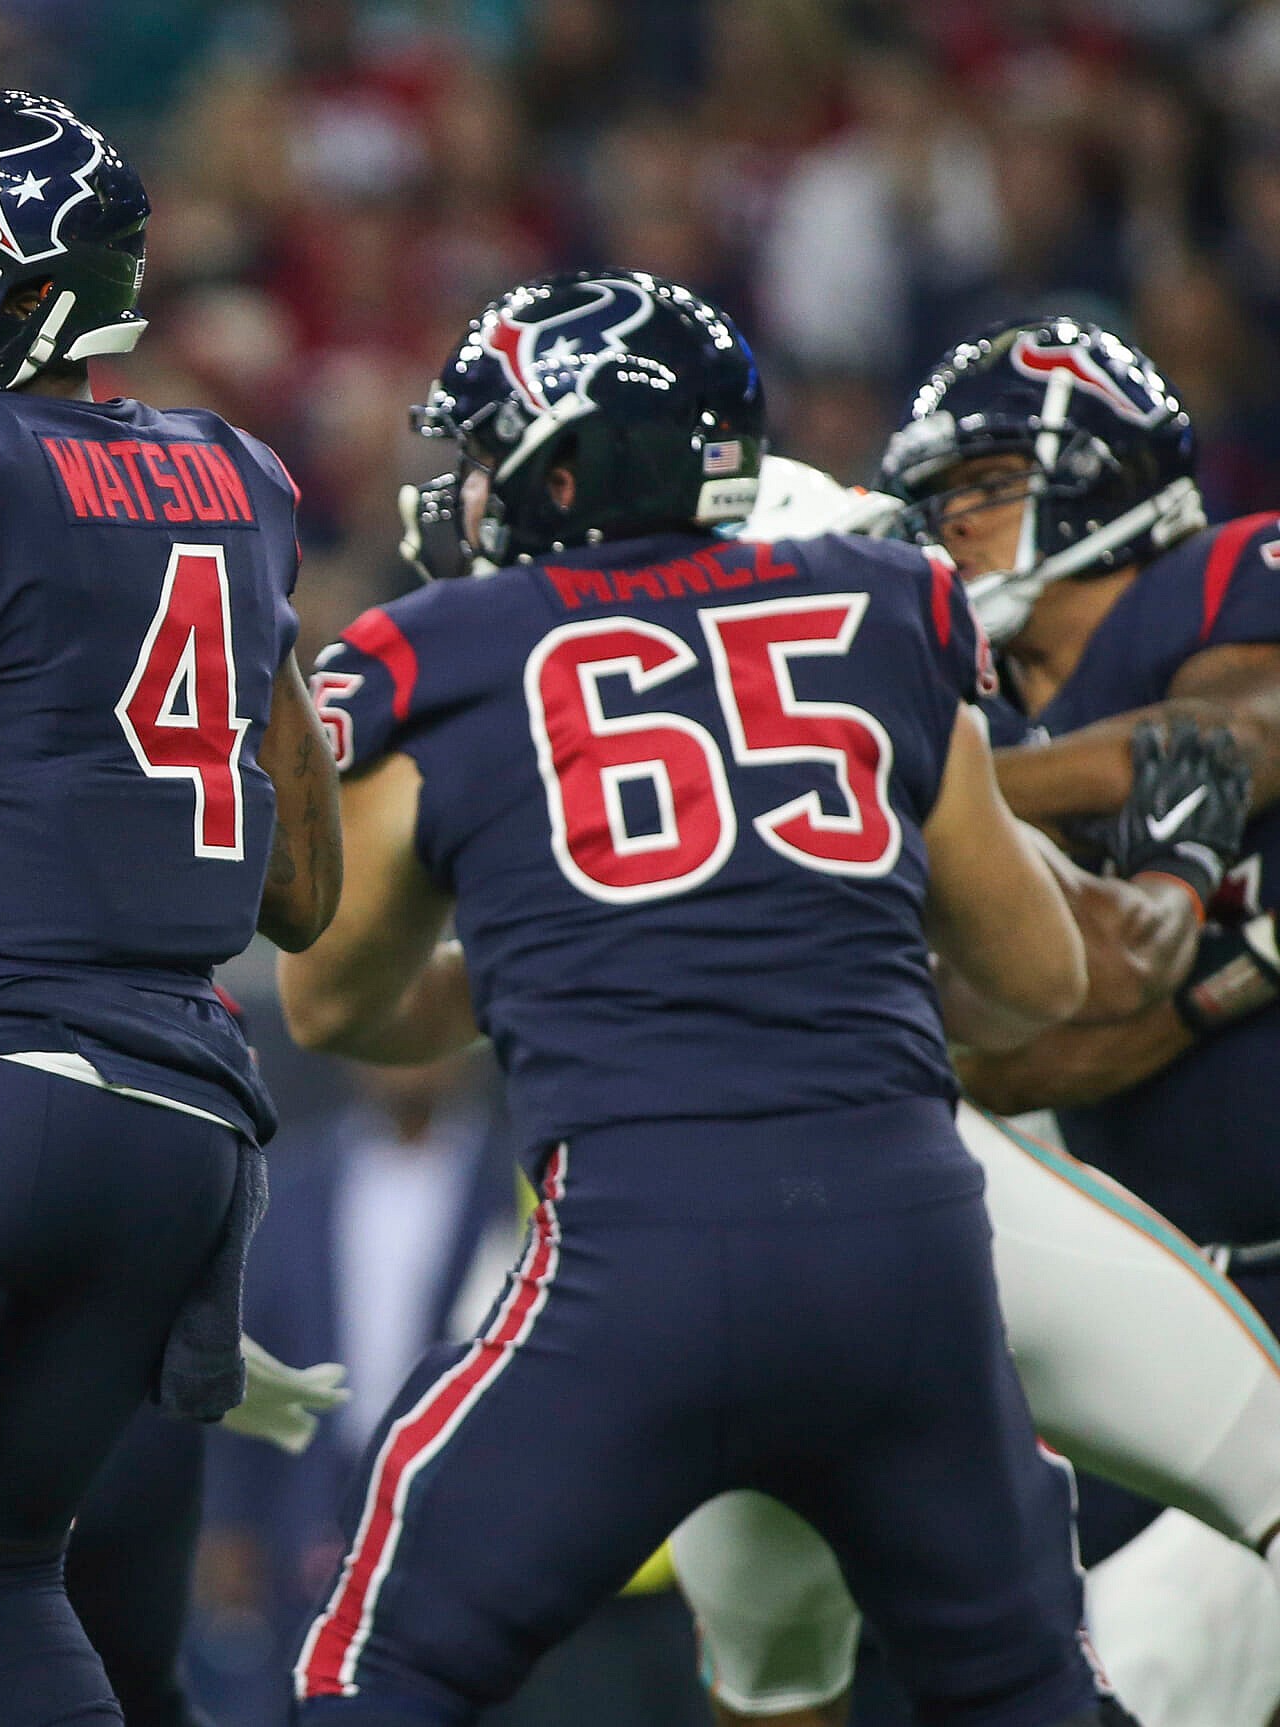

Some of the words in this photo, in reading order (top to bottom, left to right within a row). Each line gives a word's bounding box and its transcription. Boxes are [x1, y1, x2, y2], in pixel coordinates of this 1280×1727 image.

[41, 437, 254, 523] WATSON
[114, 542, 251, 860] 4
[524, 592, 902, 905] 65
